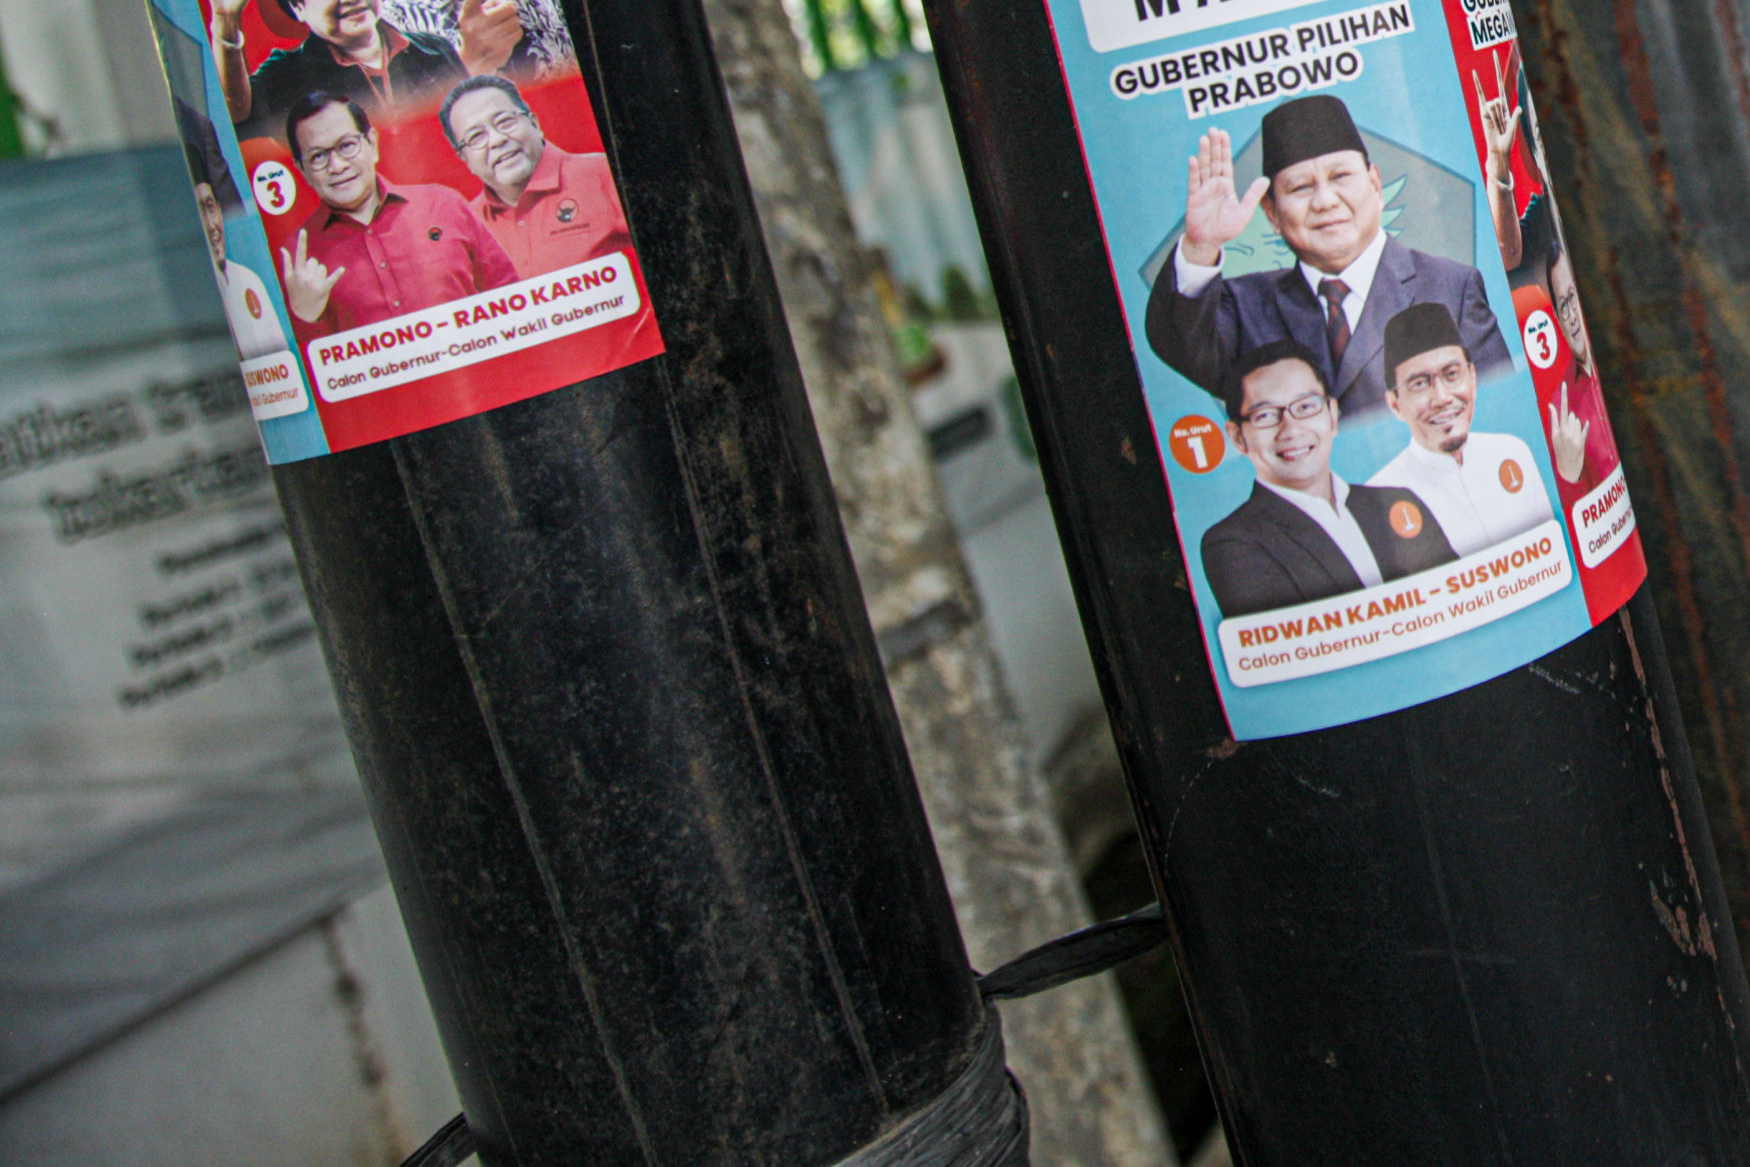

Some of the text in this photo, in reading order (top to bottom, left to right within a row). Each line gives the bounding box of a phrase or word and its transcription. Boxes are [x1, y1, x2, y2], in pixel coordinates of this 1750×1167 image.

[1115, 3, 1410, 94] GUBERNUR PILIHAN
[1188, 51, 1358, 113] PRABOWO
[267, 181, 286, 208] 3
[319, 320, 432, 365] PRAMONO
[454, 293, 528, 330] RANO
[531, 265, 617, 307] KARNO
[328, 370, 366, 390] Calon
[501, 317, 548, 342] Wakil
[552, 295, 625, 326] Gubernur
[1537, 331, 1550, 361] 3
[1187, 436, 1208, 469] 1
[1588, 530, 1612, 554] Calon
[1237, 613, 1343, 648] RIDWAN
[1347, 589, 1427, 622] KAMIL
[1446, 537, 1552, 594] SUSWONO
[1238, 651, 1291, 672] Calon
[1447, 591, 1495, 617] Wakil
[1498, 560, 1562, 600] Gubernur
